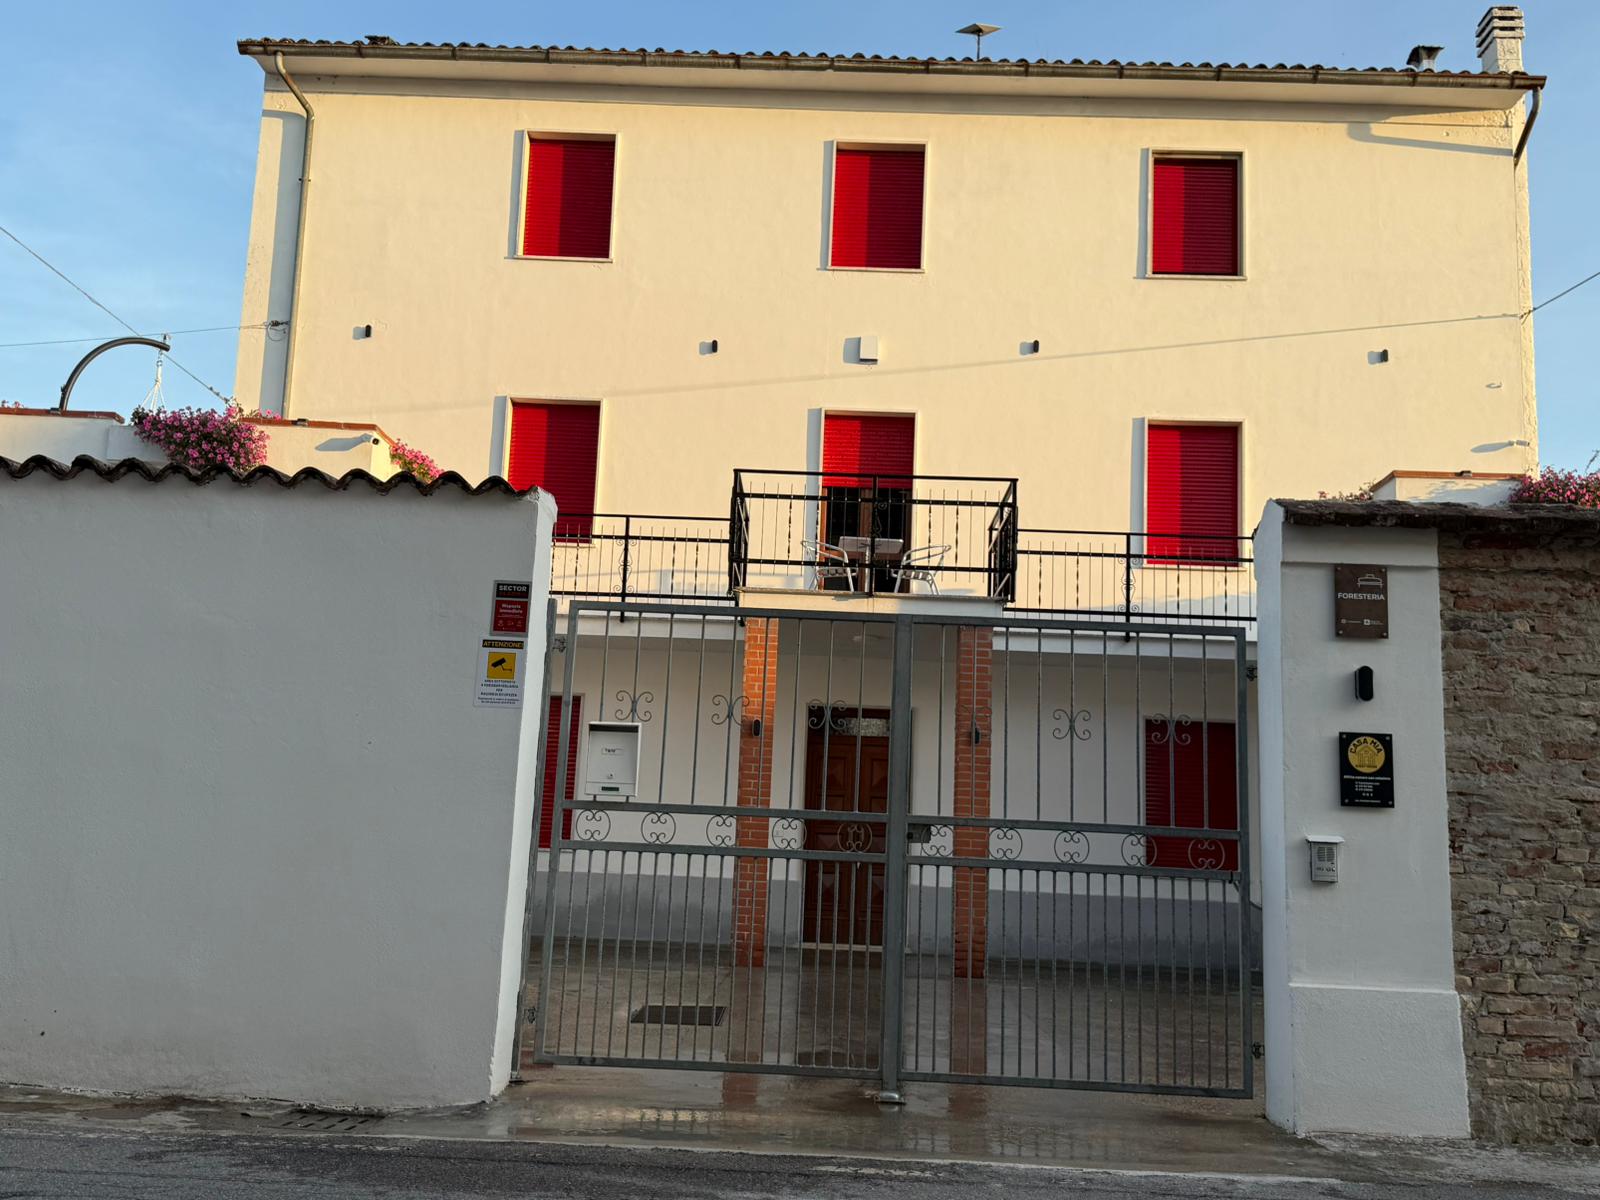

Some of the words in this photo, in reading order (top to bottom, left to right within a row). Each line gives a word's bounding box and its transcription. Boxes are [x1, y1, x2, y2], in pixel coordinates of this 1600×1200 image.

[1337, 592, 1385, 601] FORESTERIA
[1350, 738, 1368, 754] CASA
[1369, 740, 1383, 754] MIA
